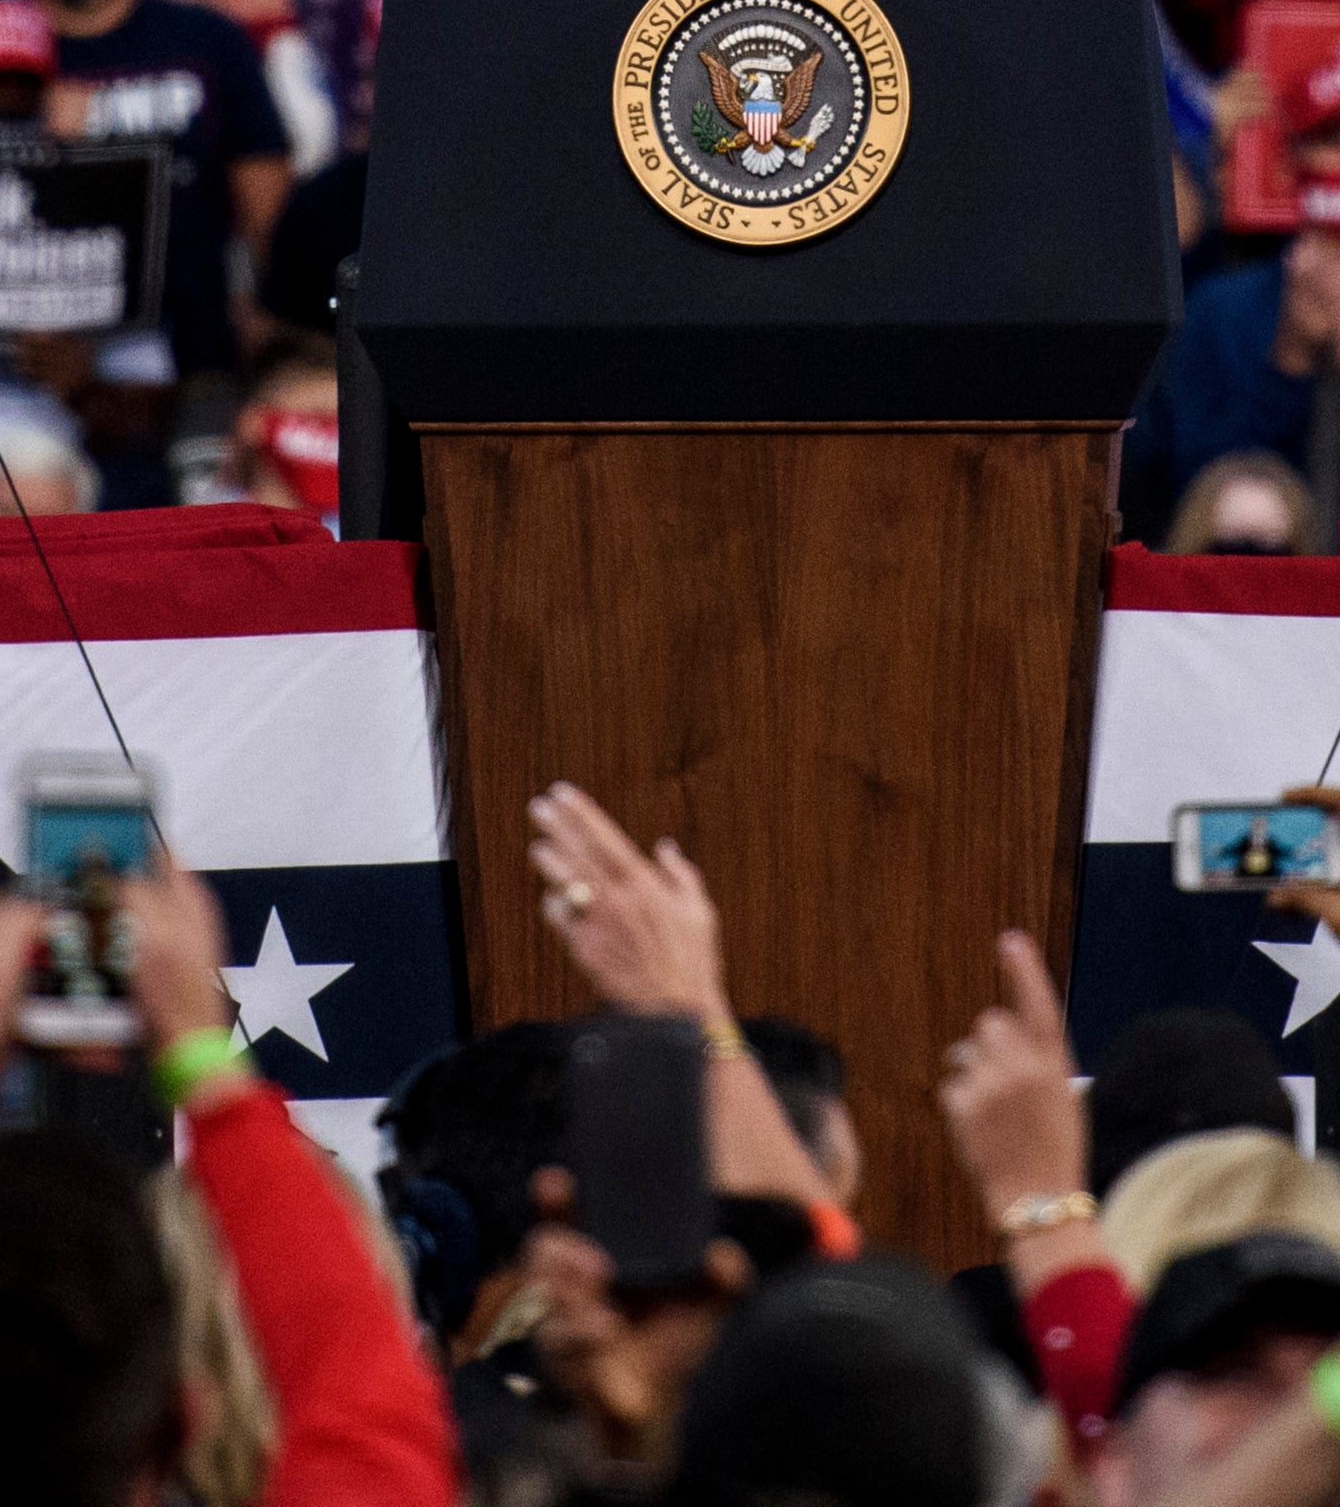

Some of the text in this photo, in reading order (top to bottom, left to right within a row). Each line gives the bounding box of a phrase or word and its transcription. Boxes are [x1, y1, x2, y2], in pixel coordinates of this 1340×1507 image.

[627, 101, 649, 141] THE
[639, 146, 661, 171] OF
[662, 169, 735, 229] SEAL
[788, 143, 886, 230] STATES
